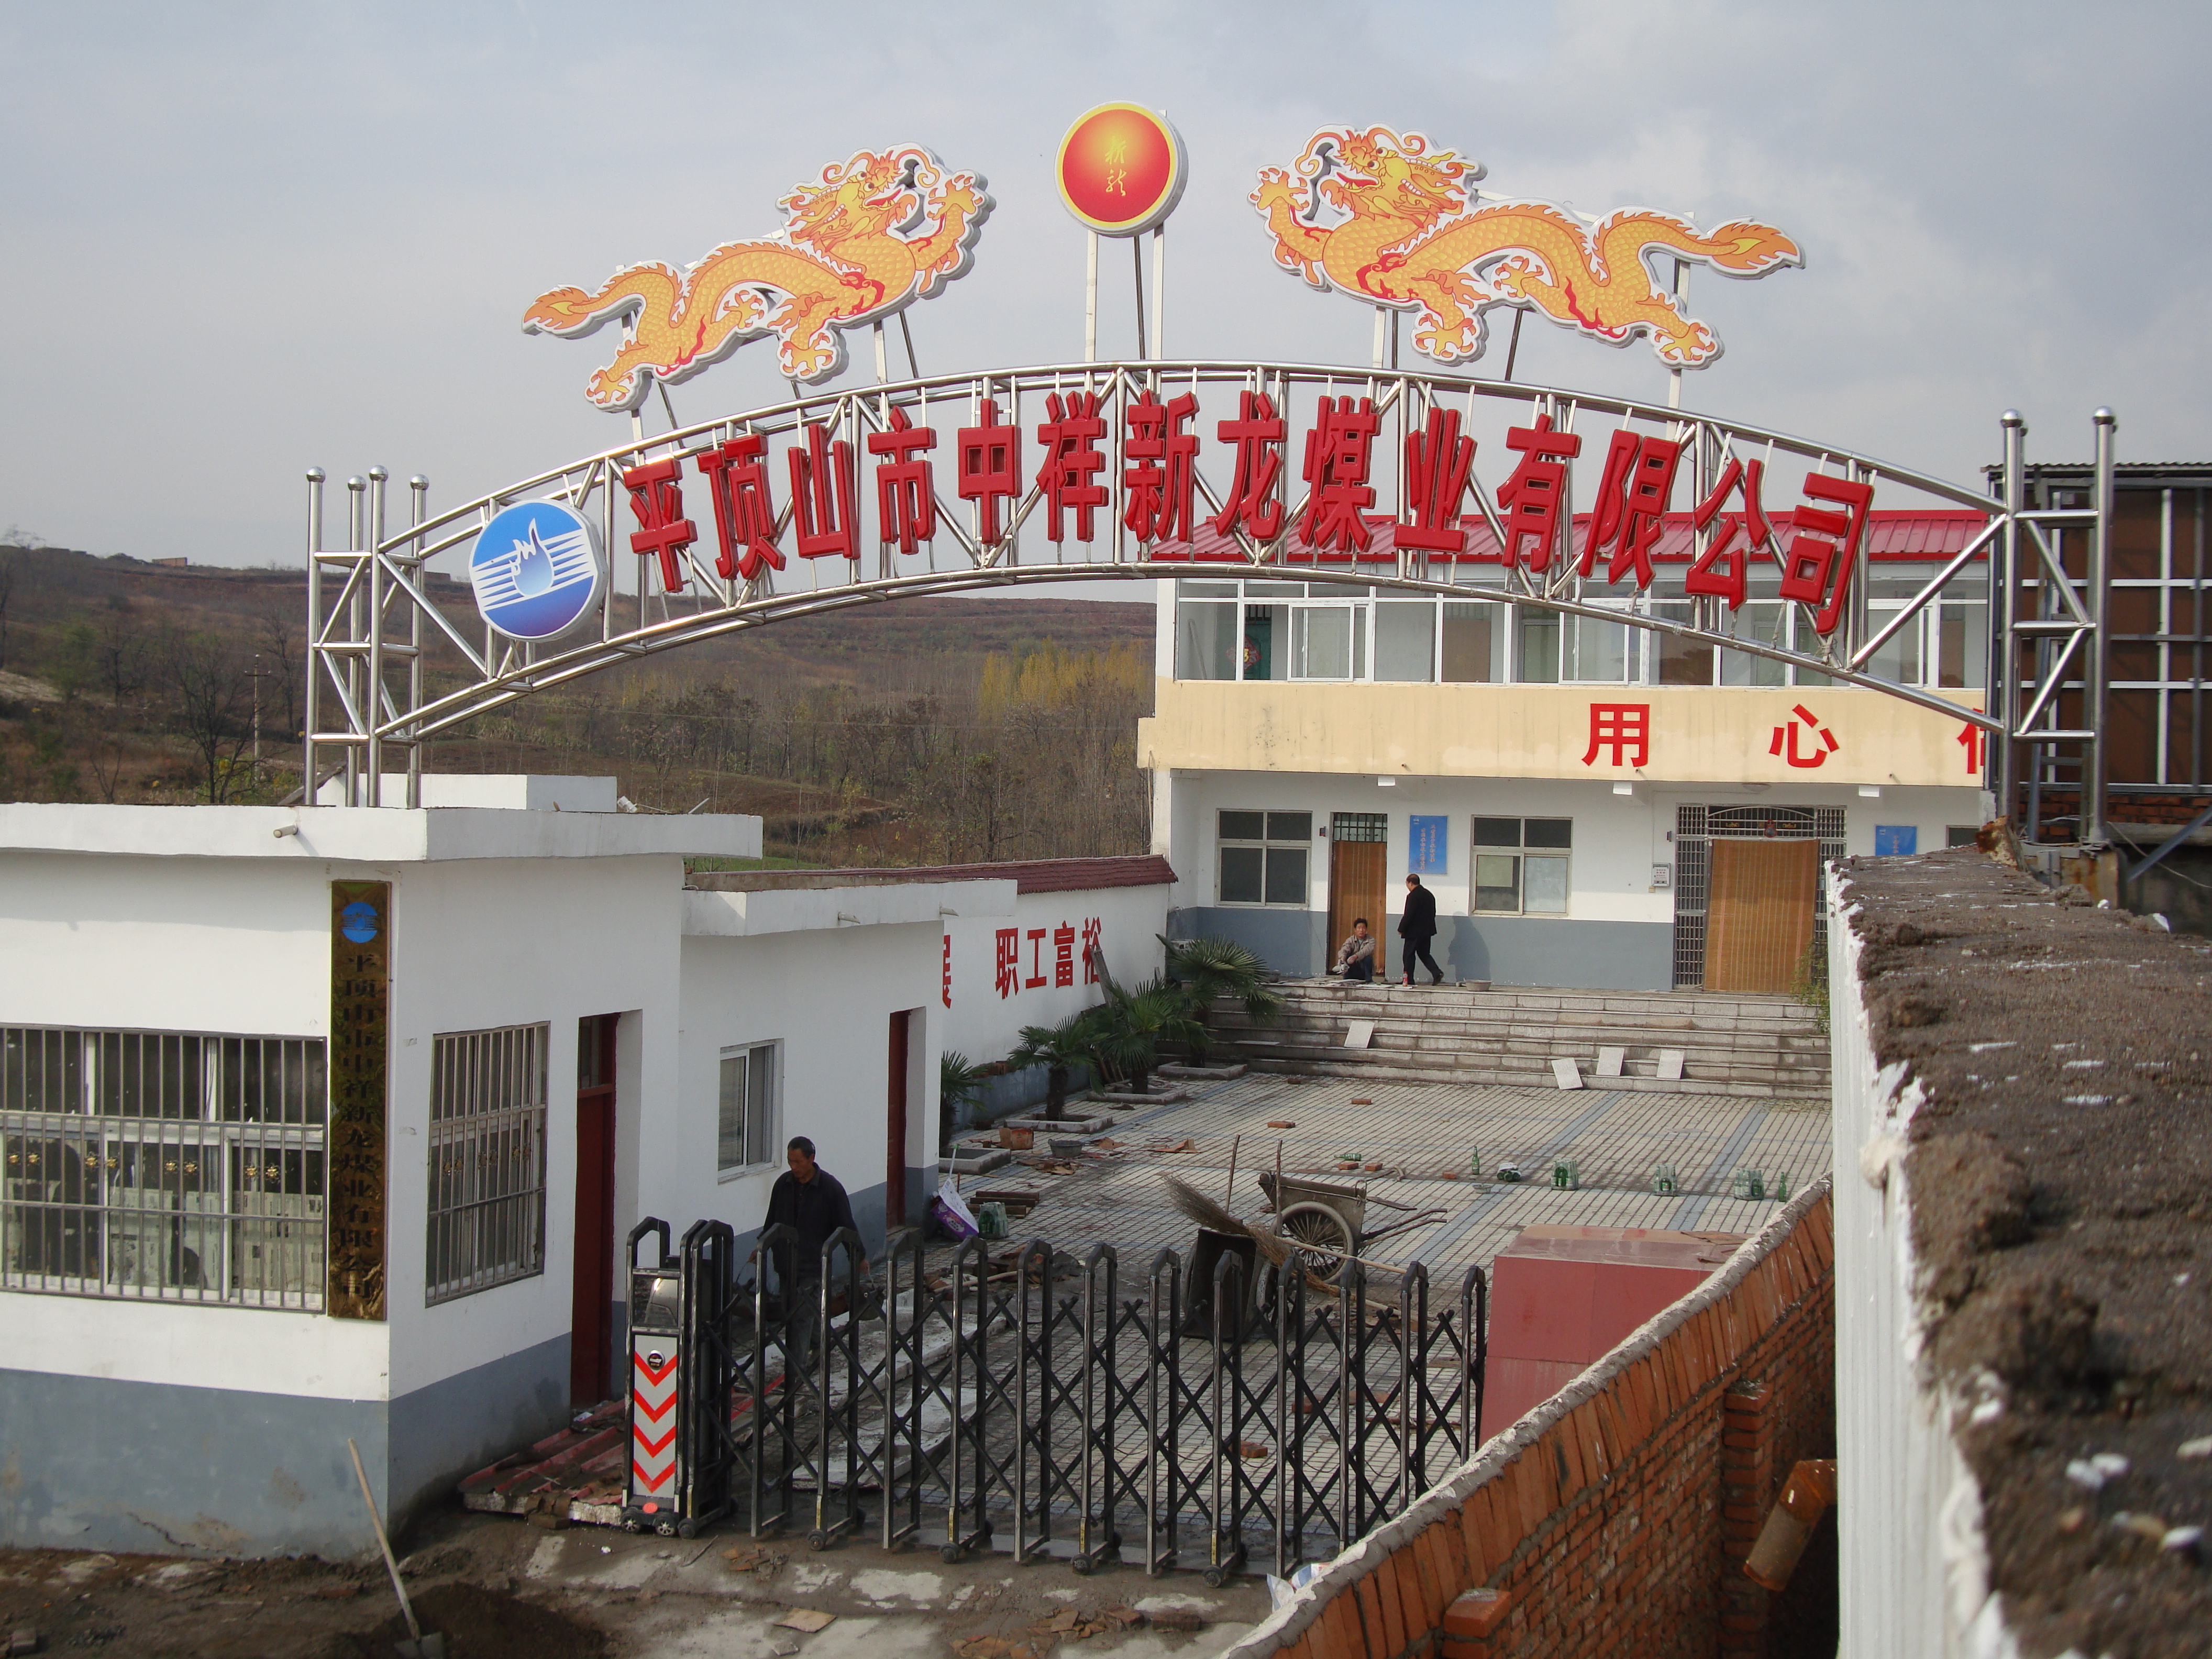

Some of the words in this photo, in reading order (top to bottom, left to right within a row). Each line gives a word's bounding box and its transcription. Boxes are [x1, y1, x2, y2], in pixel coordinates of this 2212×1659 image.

[623, 387, 1875, 636] 平顶山市中祥新龙煤业有限公司
[995, 916, 1102, 999] 职工富裕
[339, 953, 377, 1299] 平顶山市中祥新龙煤业有限公司
